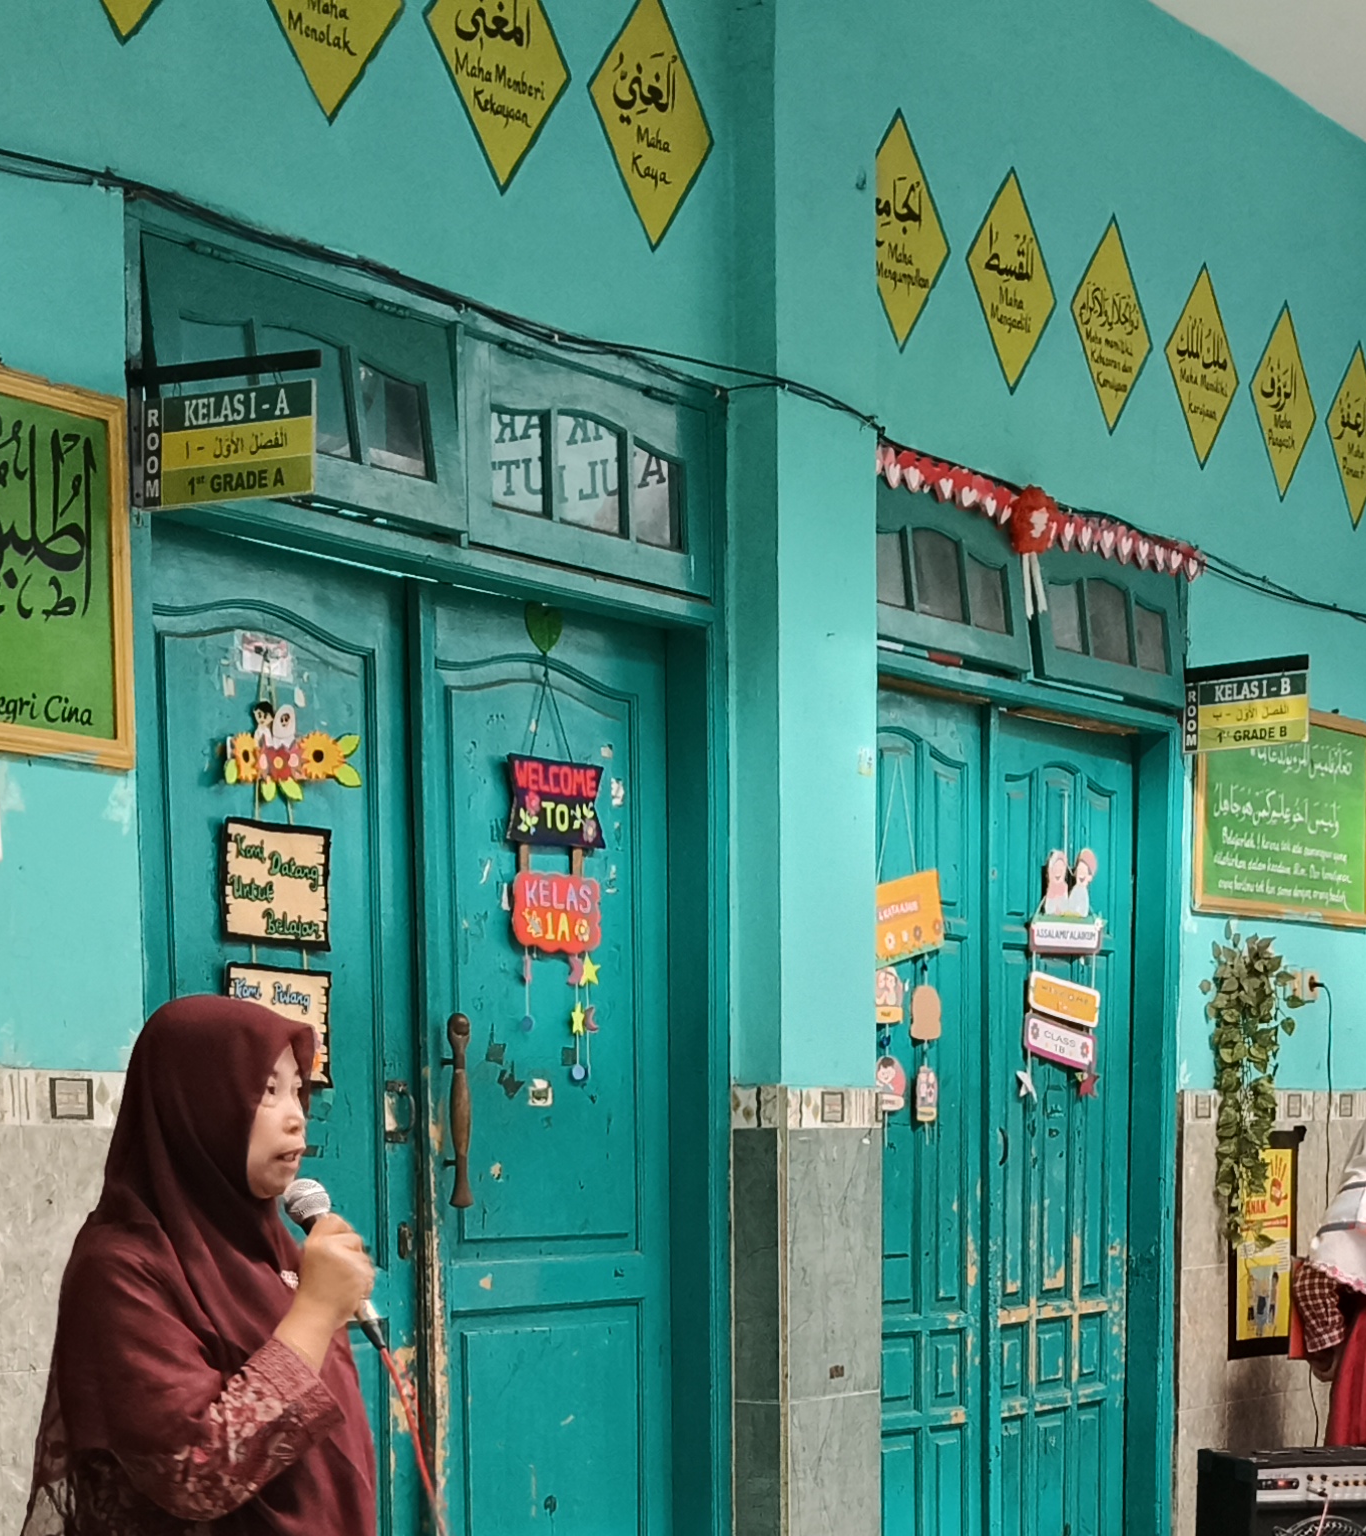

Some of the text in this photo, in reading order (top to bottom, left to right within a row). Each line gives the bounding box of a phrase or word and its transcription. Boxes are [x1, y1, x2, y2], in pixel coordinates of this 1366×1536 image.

[287, 8, 357, 56] Menolak
[454, 47, 545, 101] Maha Memberi
[473, 85, 533, 129] Kekayaan
[636, 125, 671, 153] Maha
[631, 151, 672, 193] Kaya
[888, 241, 914, 266] Maha
[999, 285, 1024, 311] Maha
[1180, 366, 1199, 387] Maha
[184, 391, 245, 427] KELAS
[249, 392, 257, 419] I
[274, 388, 290, 417] A
[146, 408, 160, 499] ROOM
[187, 467, 285, 496] 1st GRADE A
[1214, 681, 1259, 702] KELAS
[1261, 679, 1268, 697] I
[1280, 677, 1291, 695] B
[44, 695, 94, 727] Cina
[1186, 690, 1197, 747] ROOM
[1233, 727, 1275, 743] GRADE
[1279, 726, 1288, 737] B
[513, 757, 598, 799] WELCOME
[541, 800, 570, 832] TO
[268, 850, 320, 892] Datang
[229, 874, 275, 903] Untuk
[524, 879, 594, 914] KELAS
[262, 907, 322, 940] Belajar
[544, 911, 571, 940] 1A
[271, 981, 312, 1015] Pulang
[1043, 1029, 1076, 1048] CLASS
